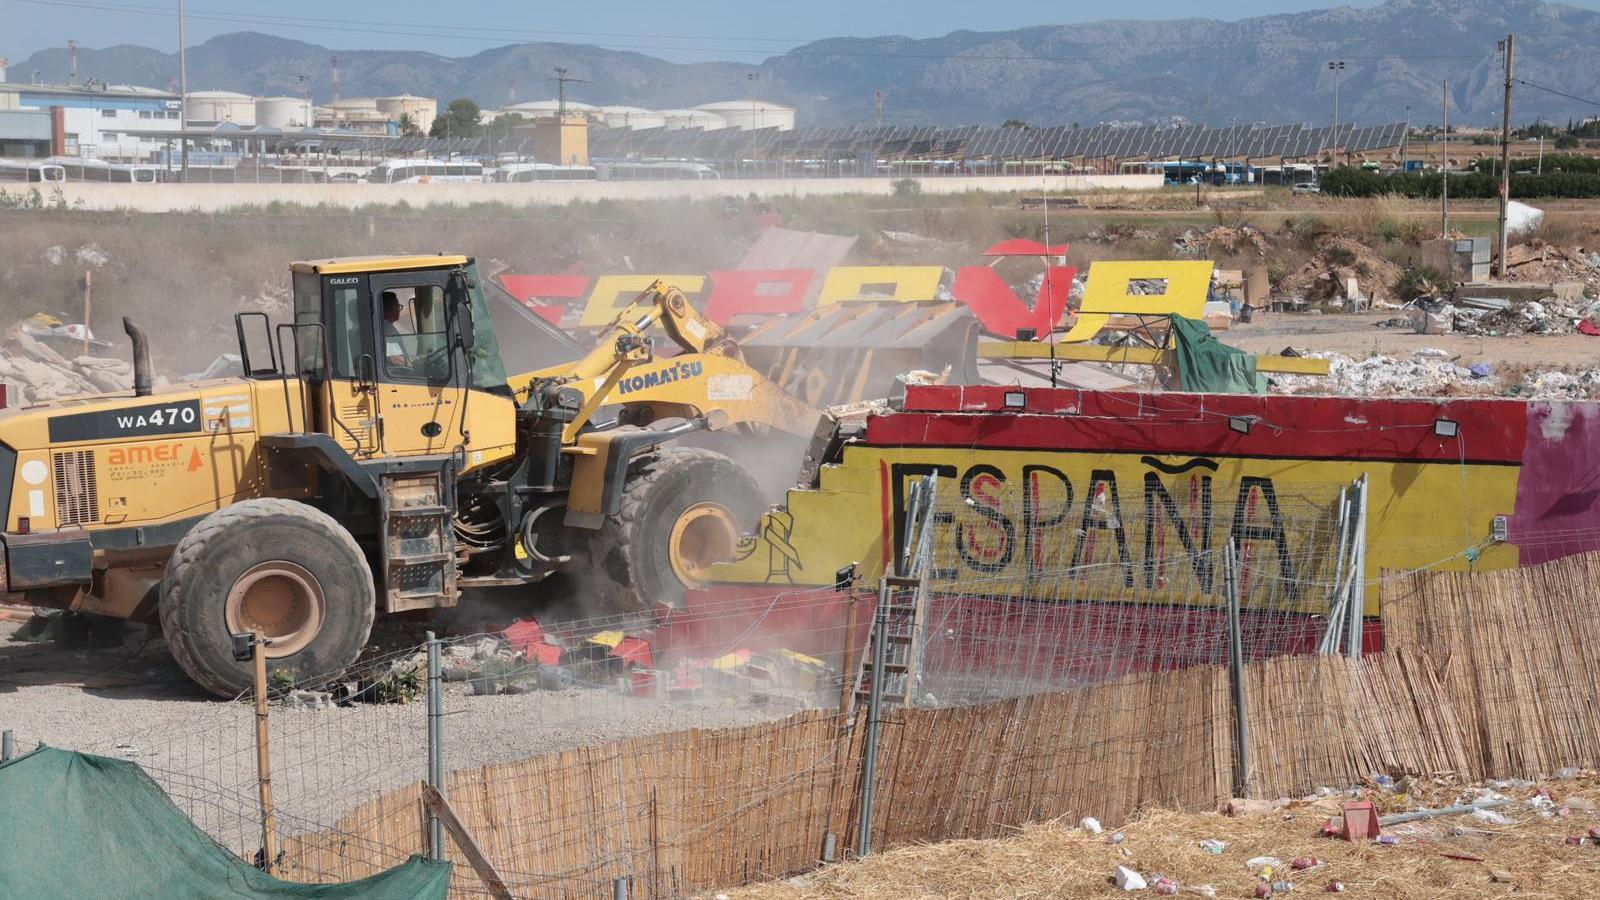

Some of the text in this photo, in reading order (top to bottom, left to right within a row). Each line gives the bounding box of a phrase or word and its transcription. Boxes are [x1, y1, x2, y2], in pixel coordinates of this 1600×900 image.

[618, 361, 703, 395] KOMATSU
[117, 406, 195, 429] WA470
[108, 443, 183, 466] amer
[891, 456, 1300, 599] ESPAÑA
